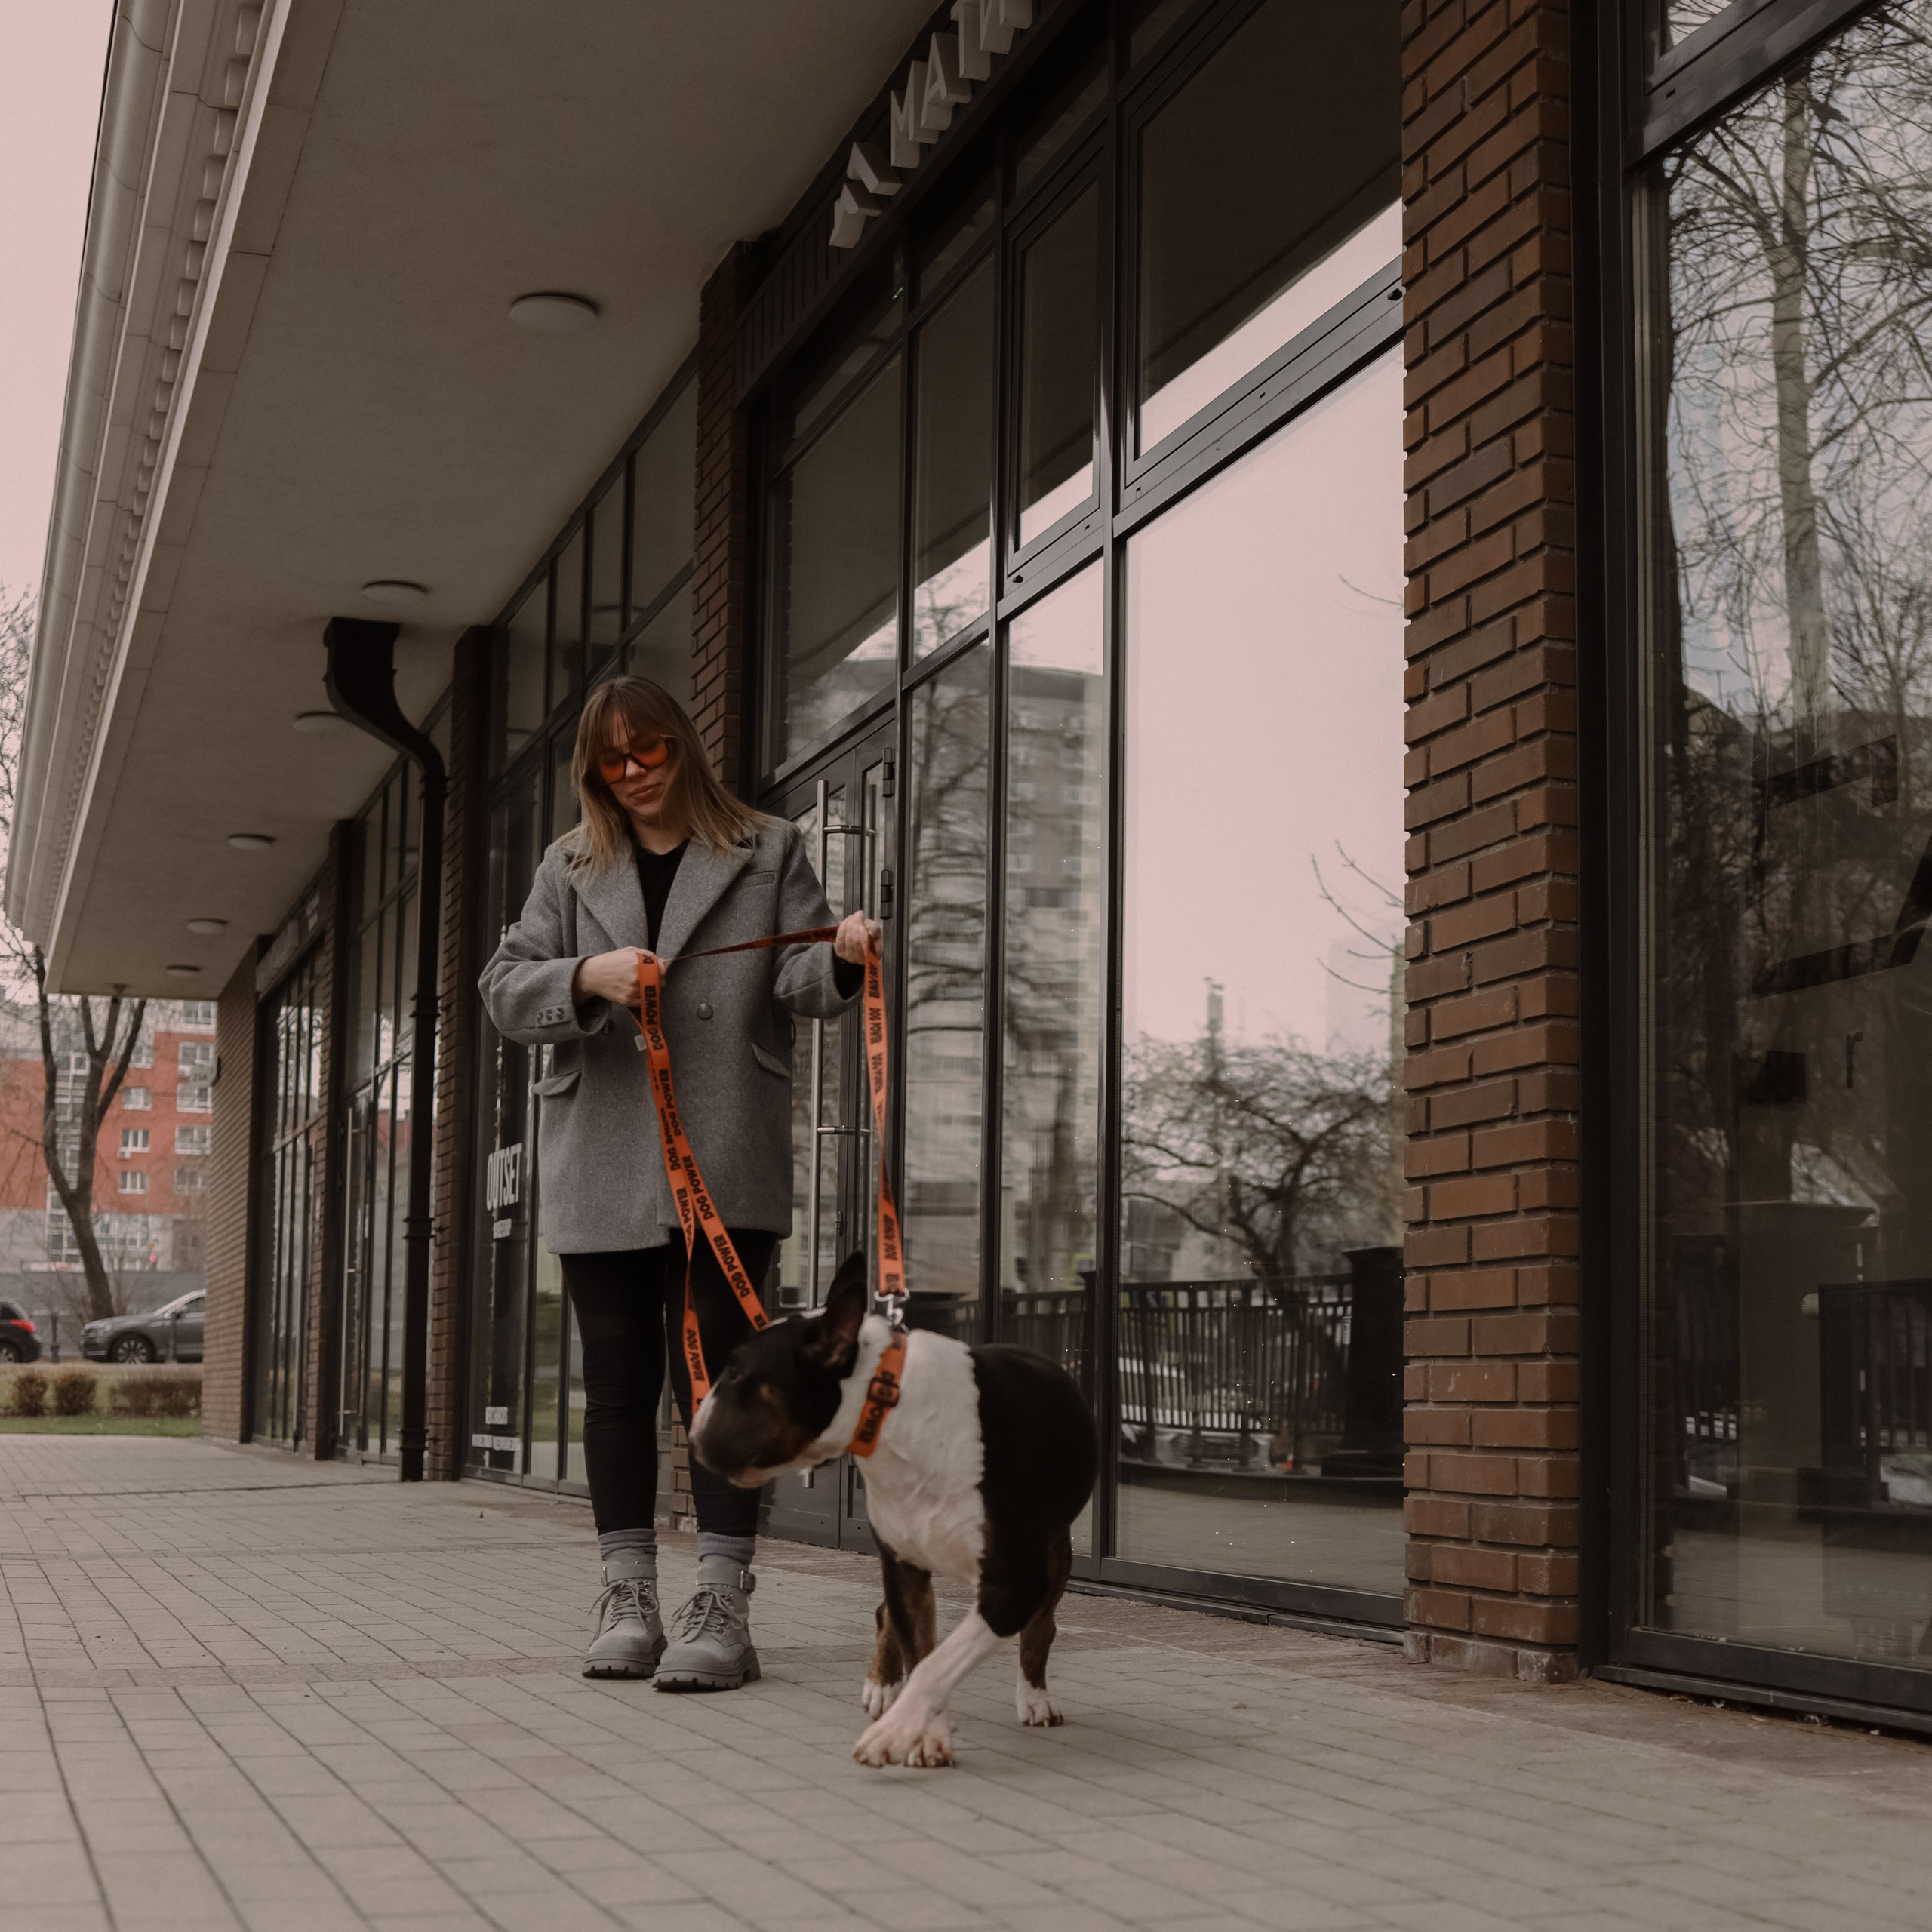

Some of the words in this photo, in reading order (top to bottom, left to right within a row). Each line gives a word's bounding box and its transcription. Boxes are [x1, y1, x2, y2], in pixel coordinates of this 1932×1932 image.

[645, 985, 657, 1026] POWER
[648, 1026, 664, 1051] DOG
[659, 1069, 674, 1109] POWER
[669, 1111, 682, 1136] DOG
[667, 1146, 681, 1171] DOG
[486, 1142, 523, 1211] OUTSET
[682, 1155, 704, 1195] POWER
[676, 1186, 691, 1226] POWER
[696, 1195, 715, 1220] DOG
[713, 1233, 739, 1272] POWER
[731, 1272, 751, 1297] DOG
[686, 1328, 698, 1351] DOG
[688, 1351, 705, 1383] POWER
